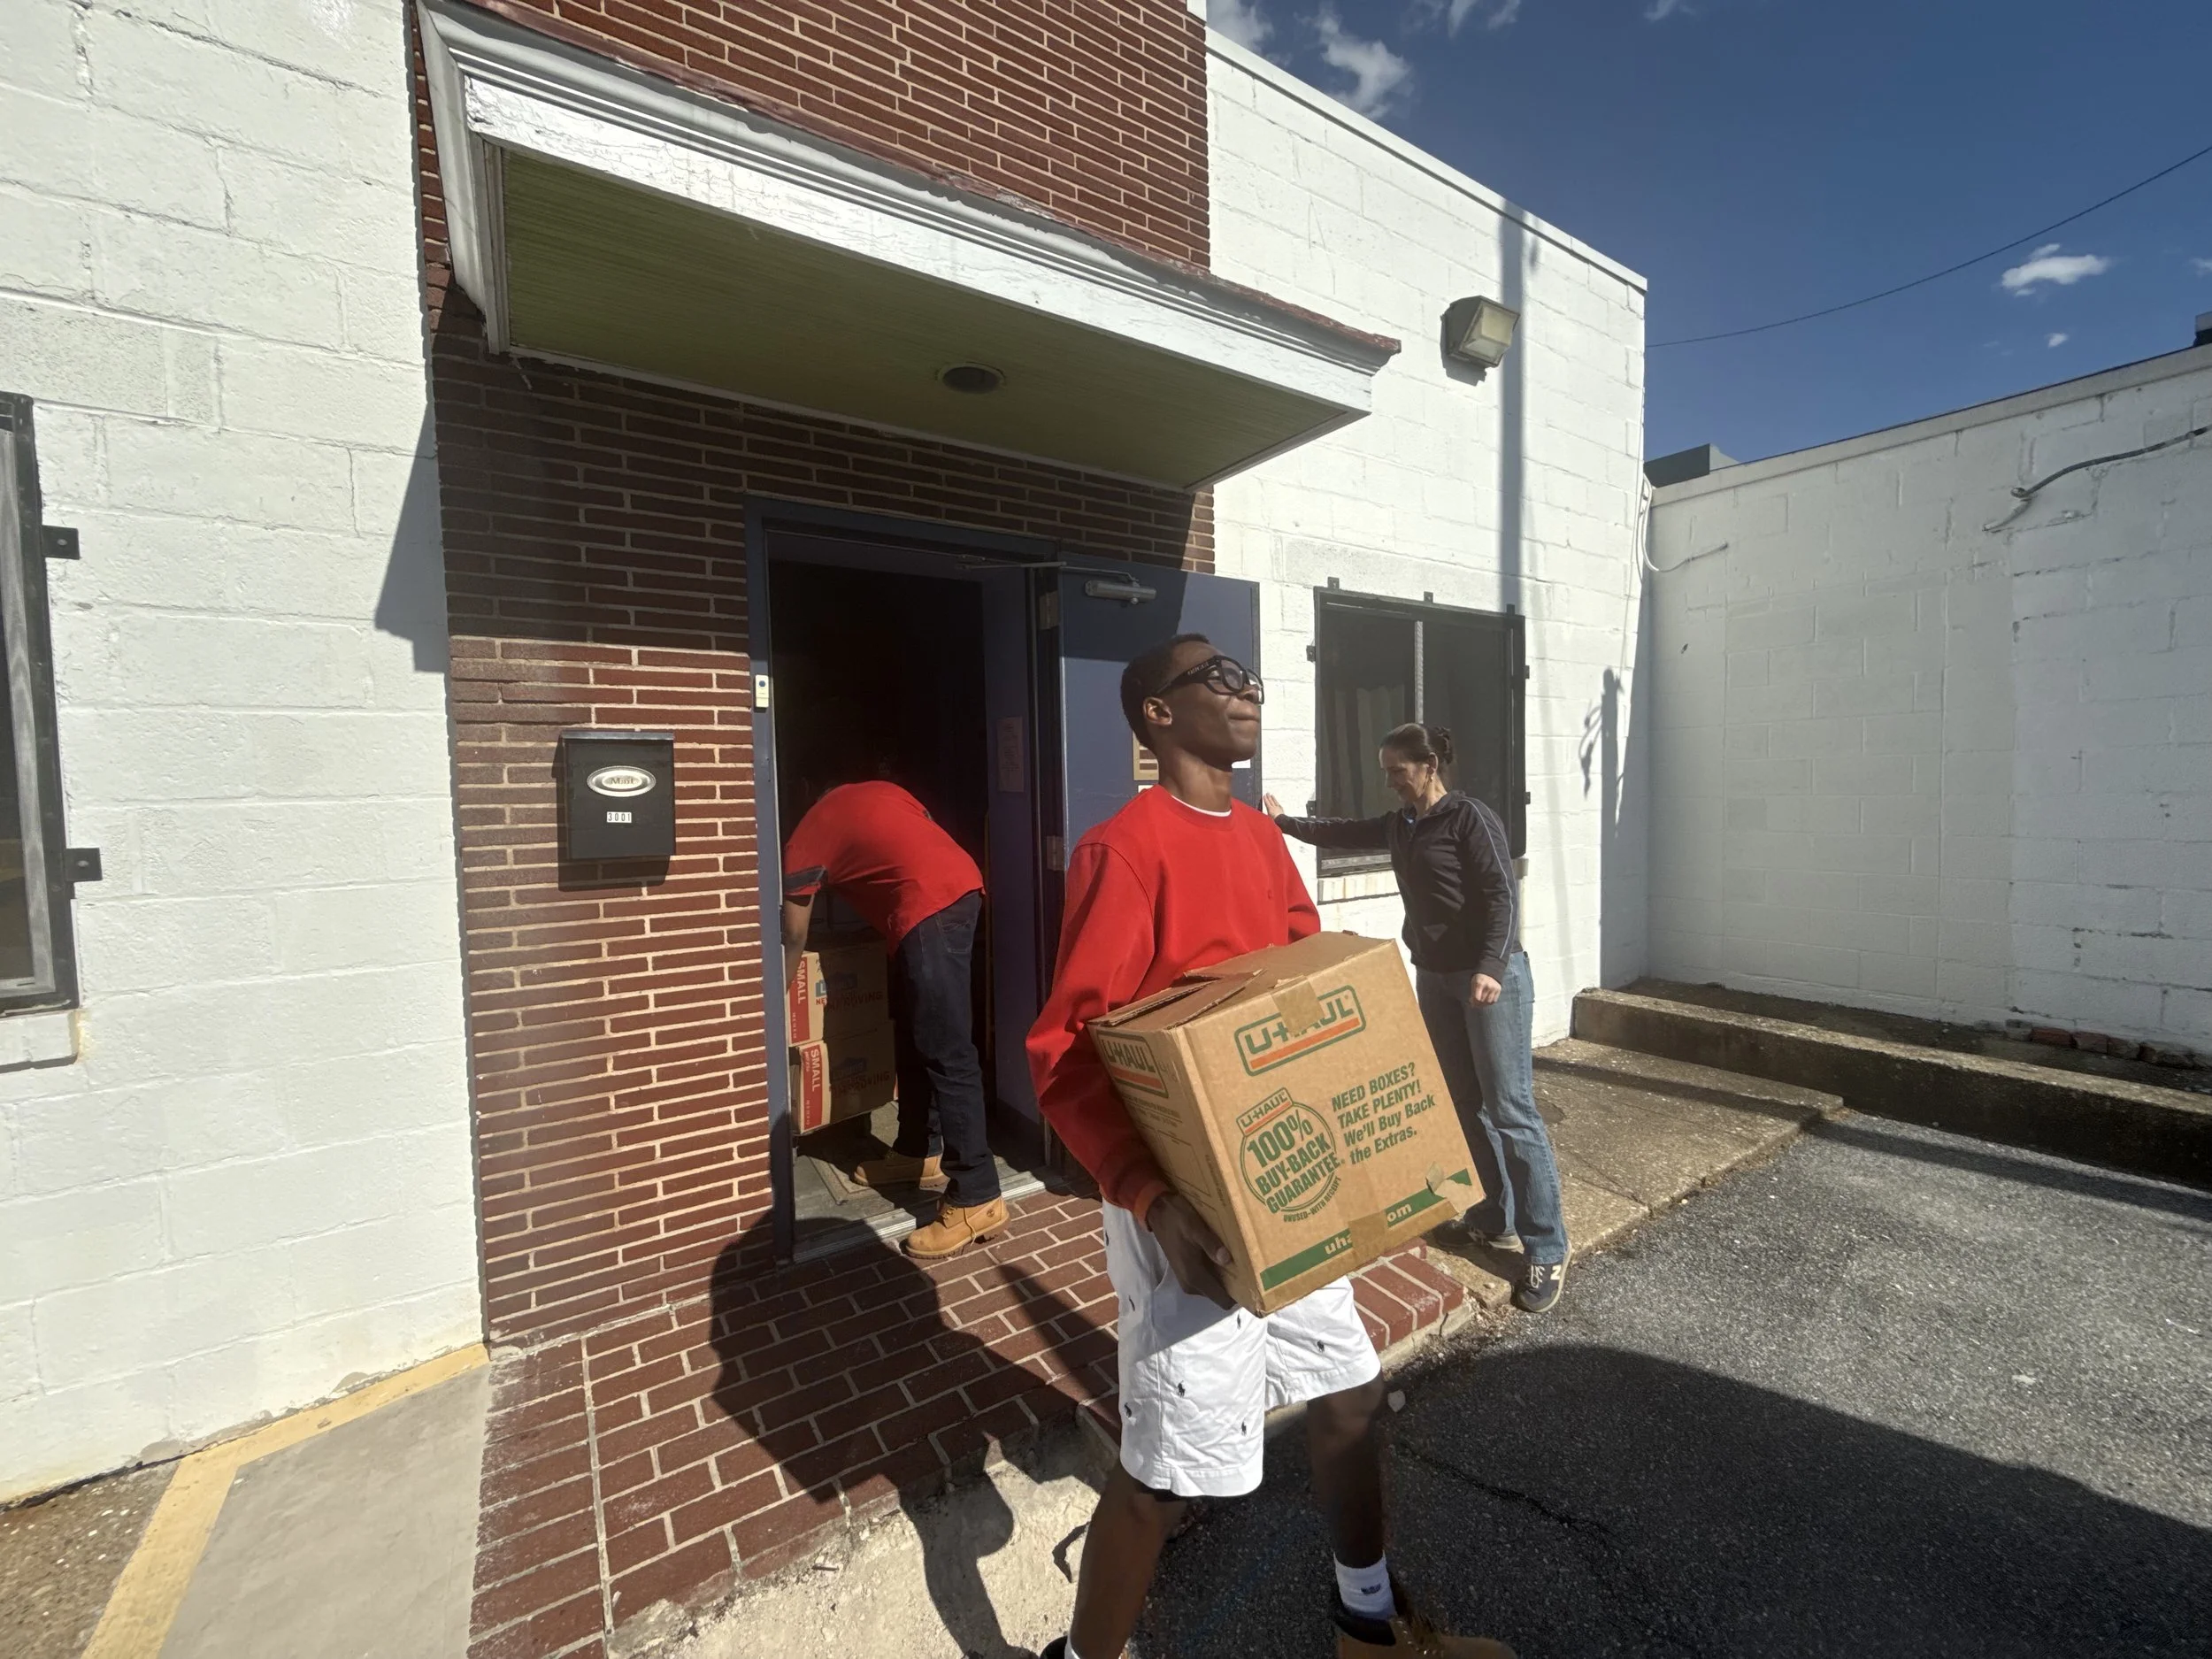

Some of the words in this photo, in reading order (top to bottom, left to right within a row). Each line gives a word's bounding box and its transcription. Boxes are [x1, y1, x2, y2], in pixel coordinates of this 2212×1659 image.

[608, 812, 631, 822] 3001
[796, 960, 806, 1005] SMALL
[810, 1048, 820, 1093] SMALL
[1332, 1085, 1366, 1112] NEED
[1369, 1062, 1415, 1095] BOXES?
[1337, 1102, 1371, 1129] TAKE
[1372, 1079, 1421, 1114] PLENTY!
[1343, 1120, 1376, 1148] We'll
[1379, 1111, 1402, 1132] Buy
[1404, 1094, 1436, 1119] Back
[1247, 1110, 1313, 1168] 100%
[1349, 1147, 1371, 1165] the
[1374, 1125, 1417, 1154] Extras.
[1255, 1133, 1332, 1196] BUY-BACK
